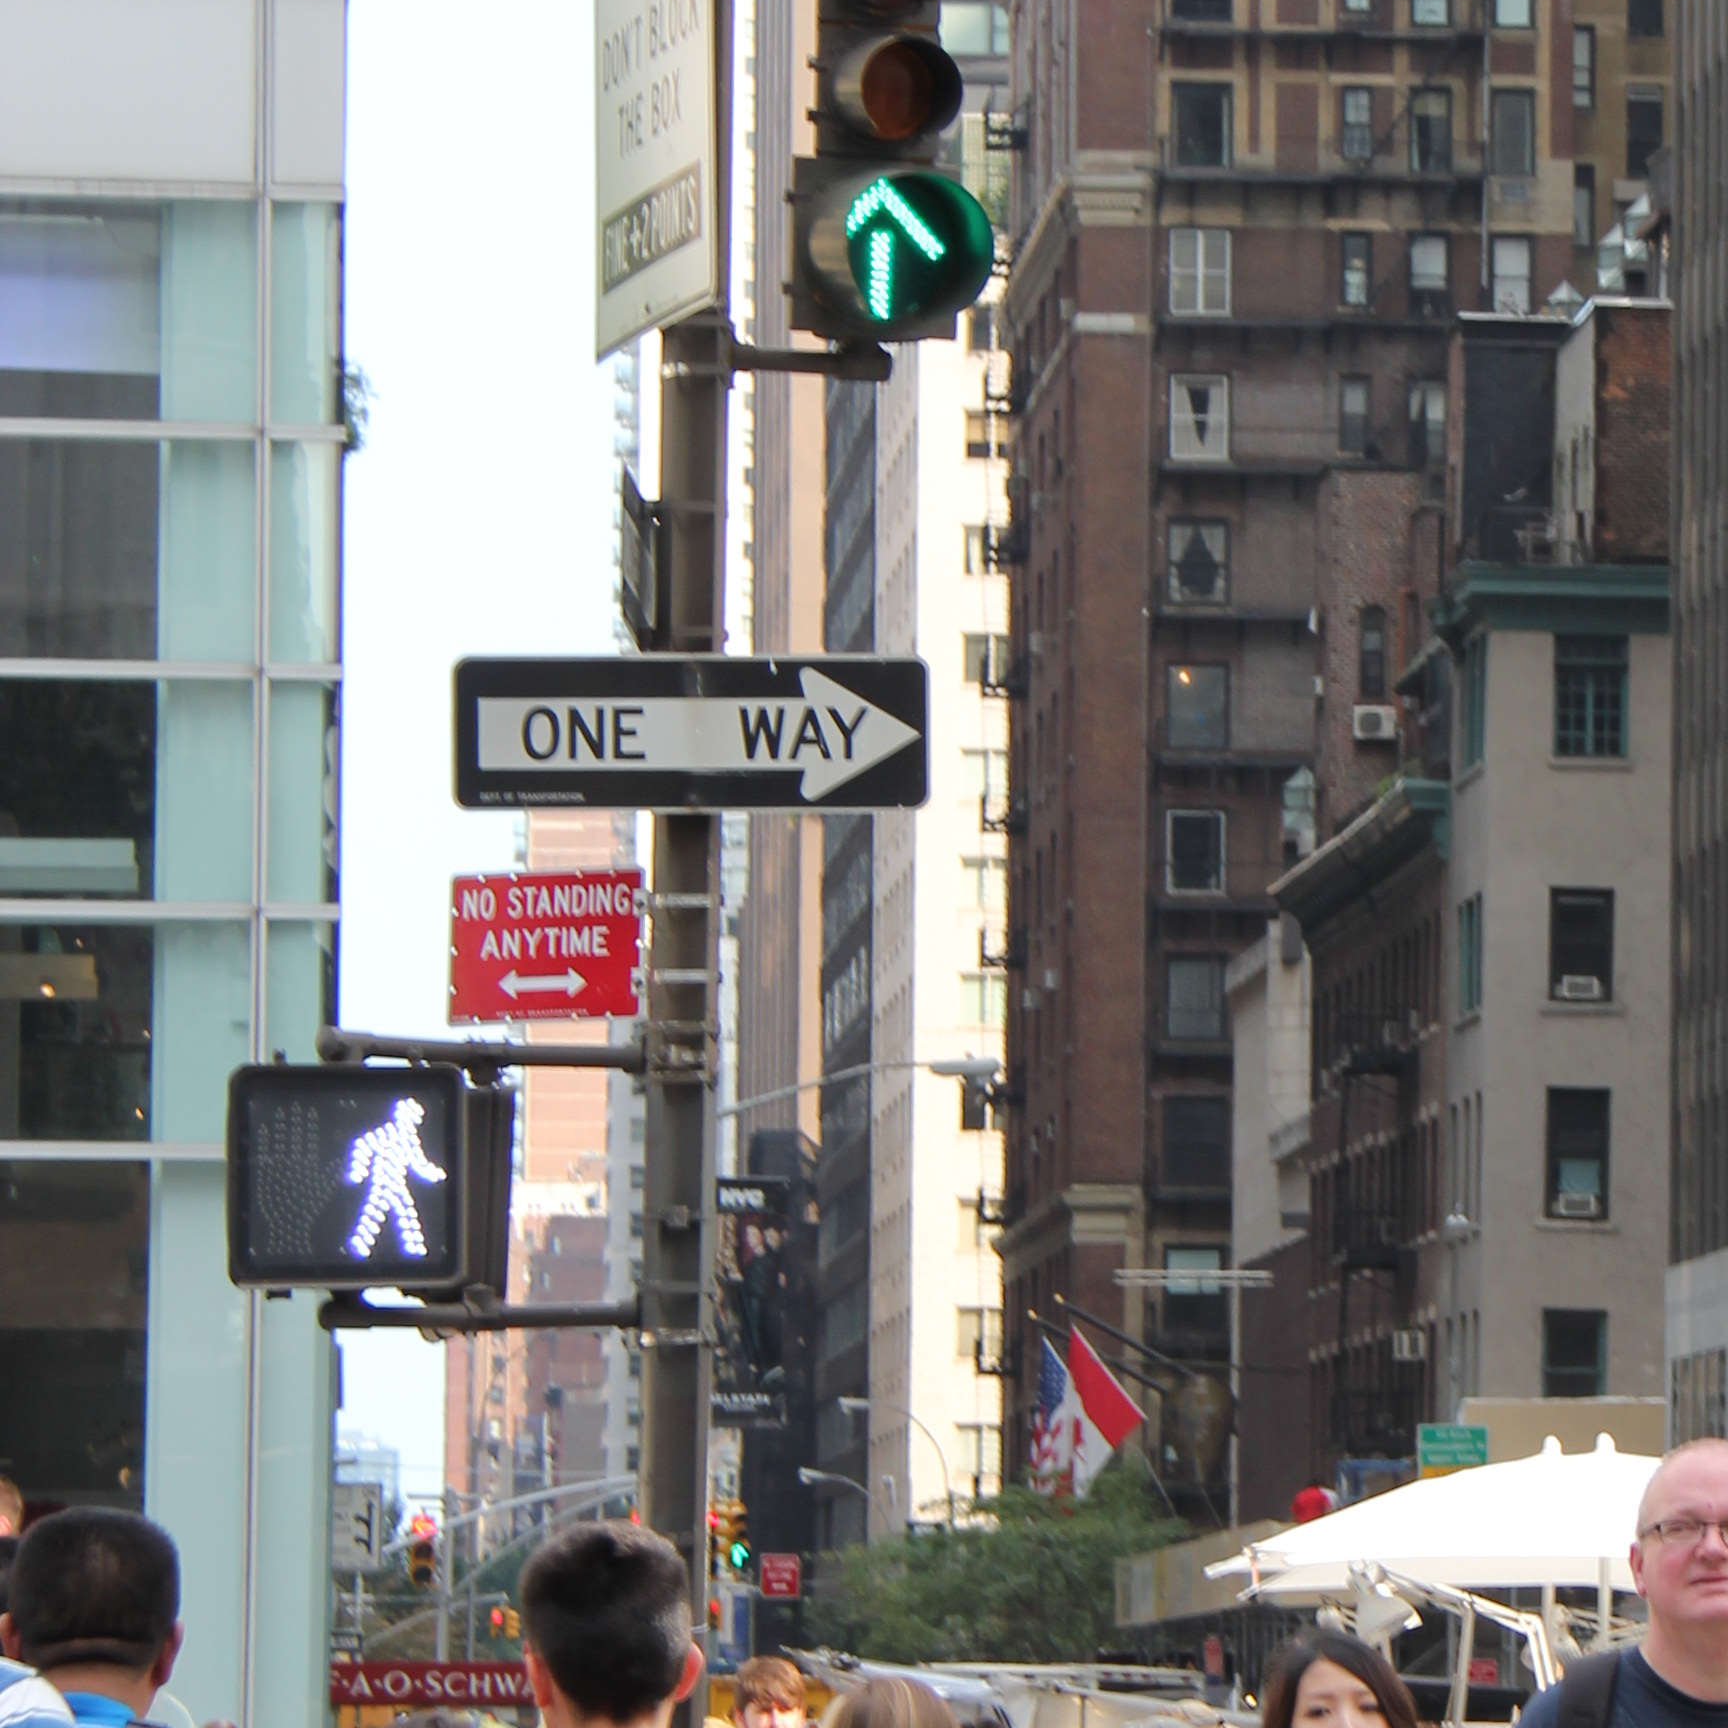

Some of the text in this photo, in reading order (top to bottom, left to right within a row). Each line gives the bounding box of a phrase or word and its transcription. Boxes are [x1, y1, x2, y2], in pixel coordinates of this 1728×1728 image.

[618, 68, 681, 159] THE BOX
[651, 174, 697, 256] POINTS
[522, 705, 870, 760] ONE WAY
[462, 883, 632, 922] NO STANDING
[480, 925, 611, 962] ANYTIME
[719, 1187, 766, 1209] NYC
